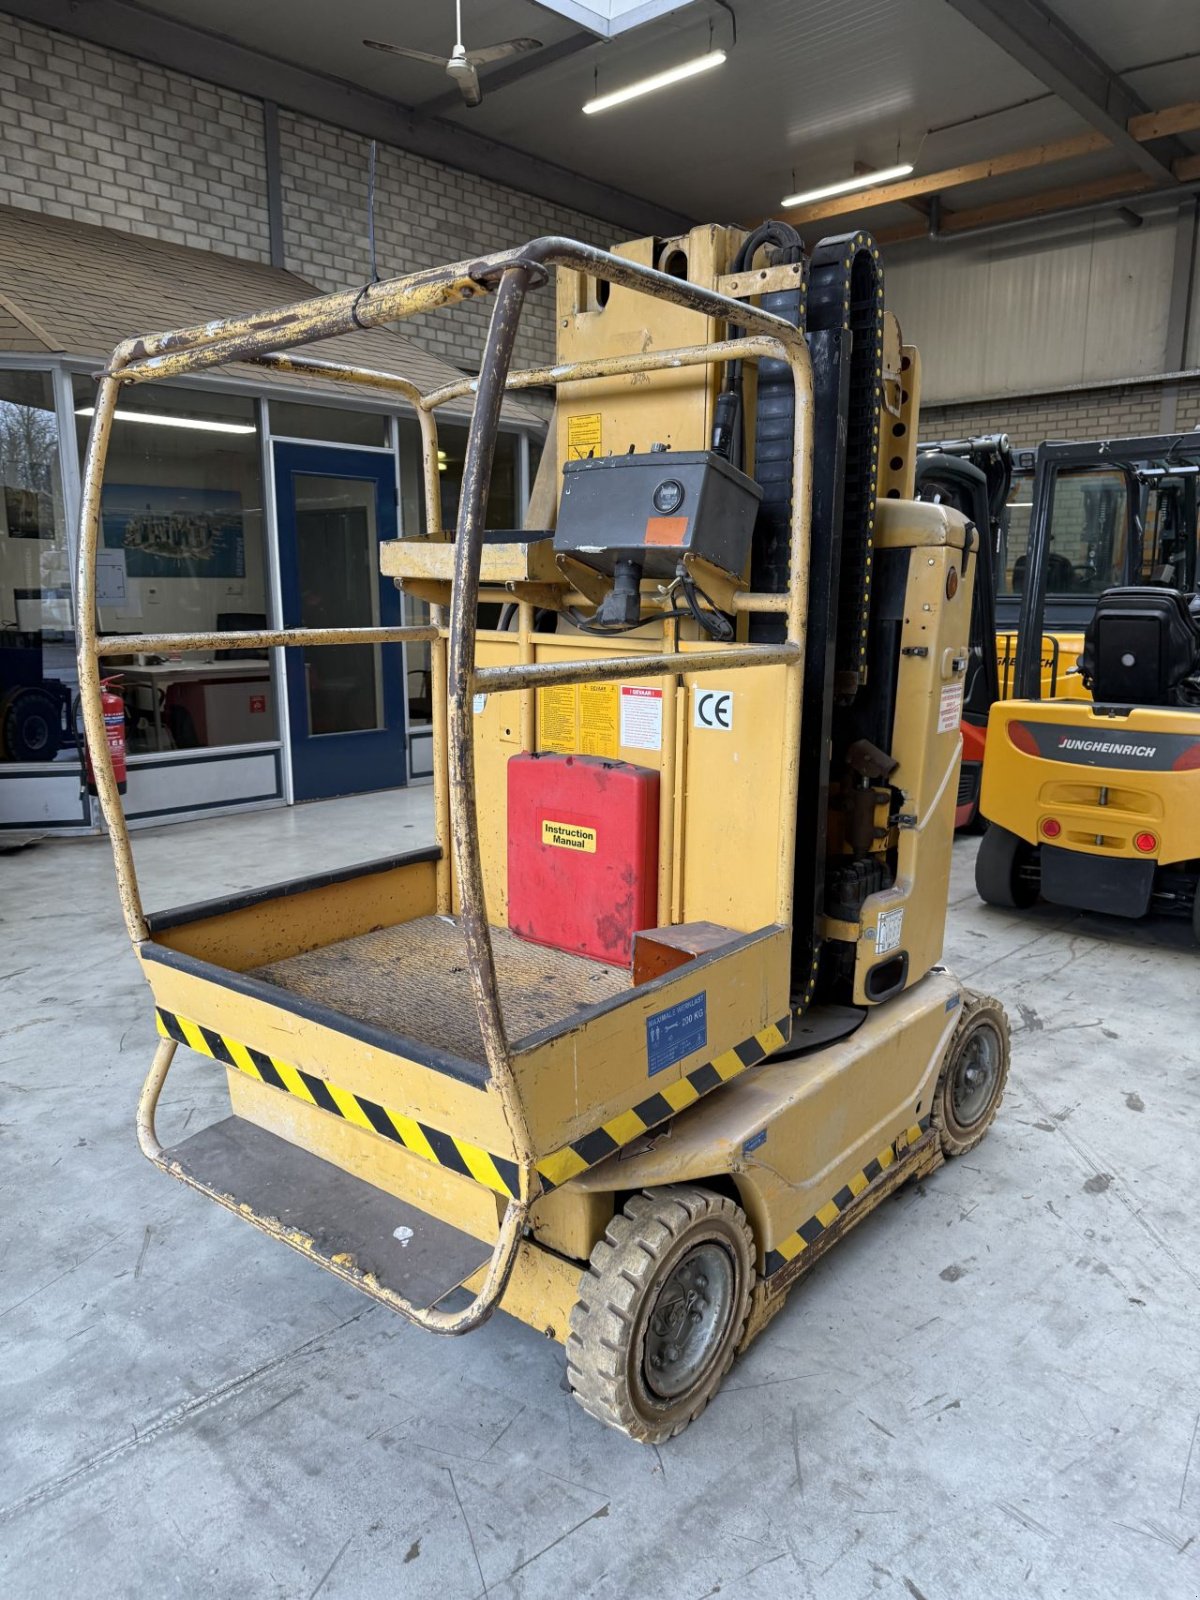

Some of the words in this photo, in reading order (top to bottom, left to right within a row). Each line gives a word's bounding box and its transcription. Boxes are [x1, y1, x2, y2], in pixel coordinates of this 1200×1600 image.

[698, 693, 730, 728] CE
[1058, 738, 1156, 758] JUNGHEINRICH
[545, 824, 593, 840] Instruction
[553, 835, 584, 848] Manual
[694, 1008, 704, 1020] KG
